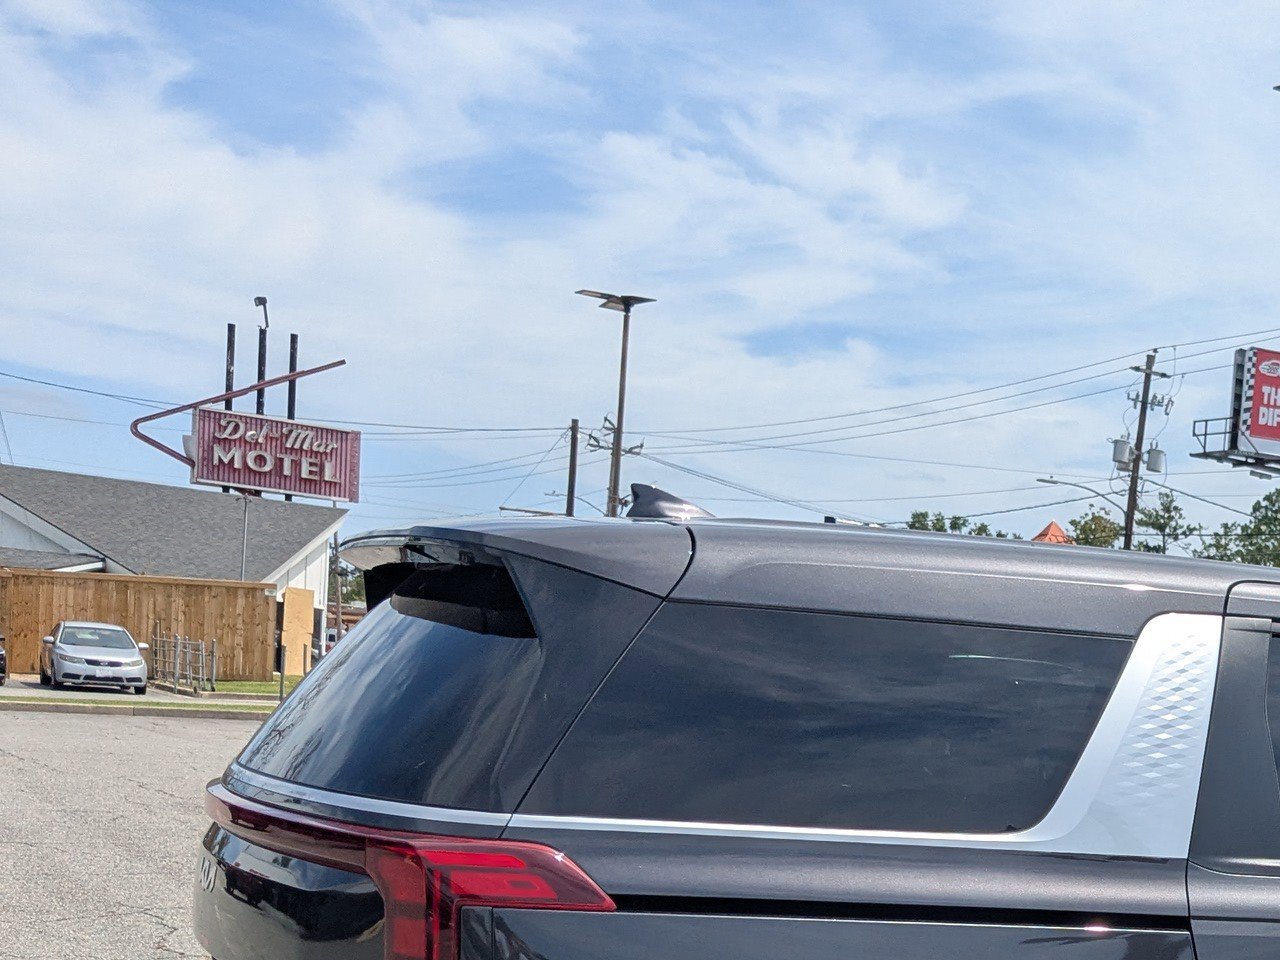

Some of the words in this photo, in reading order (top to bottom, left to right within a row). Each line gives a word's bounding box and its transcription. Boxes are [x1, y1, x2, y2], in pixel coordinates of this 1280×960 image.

[214, 418, 271, 443] Del
[282, 427, 338, 453] Mar
[212, 443, 341, 483] MOTEL
